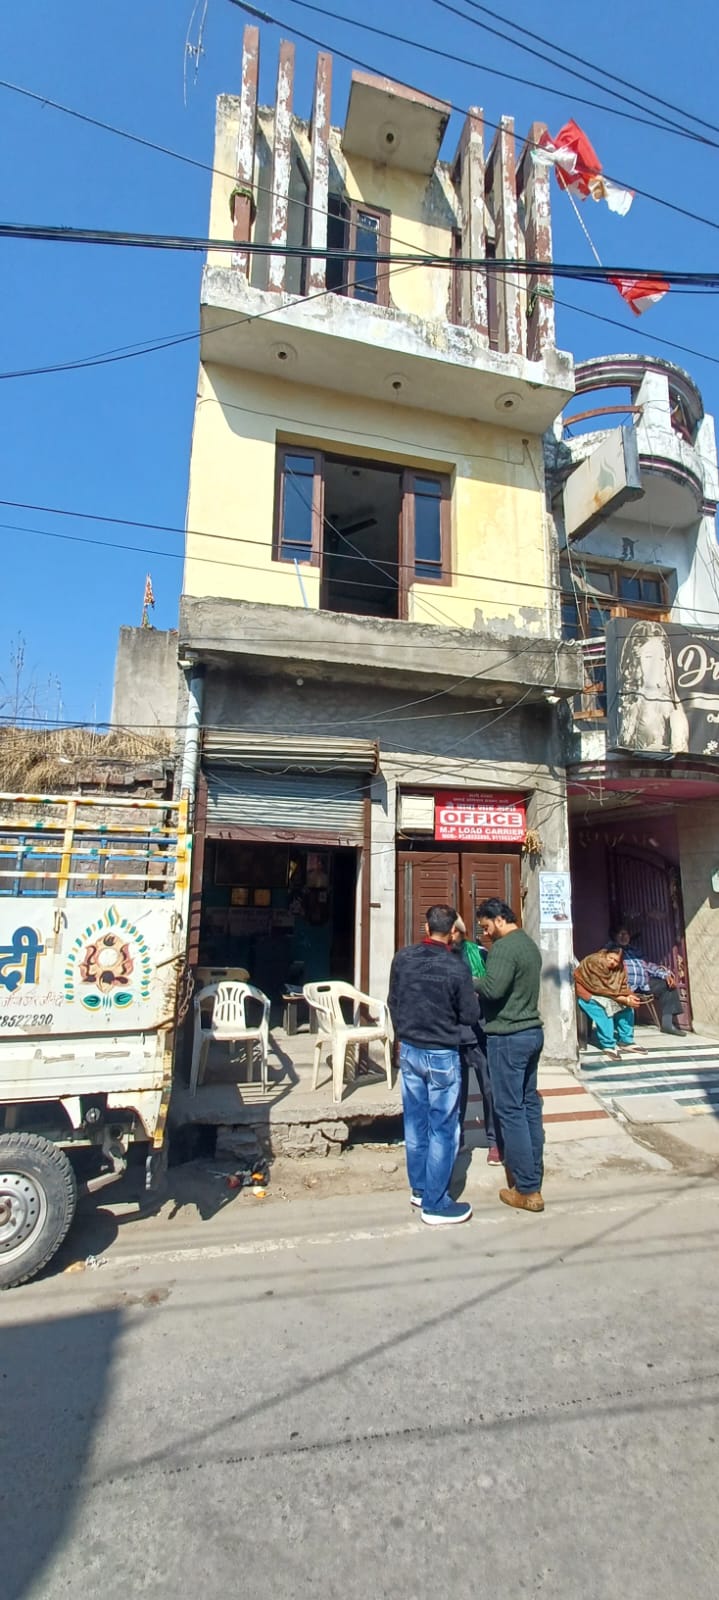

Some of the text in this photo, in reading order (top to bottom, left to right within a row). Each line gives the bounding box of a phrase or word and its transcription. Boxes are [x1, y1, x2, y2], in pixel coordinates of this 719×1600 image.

[443, 812, 520, 826] OFFICE
[458, 827, 483, 835] LOAD
[484, 828, 524, 836] CARRIER
